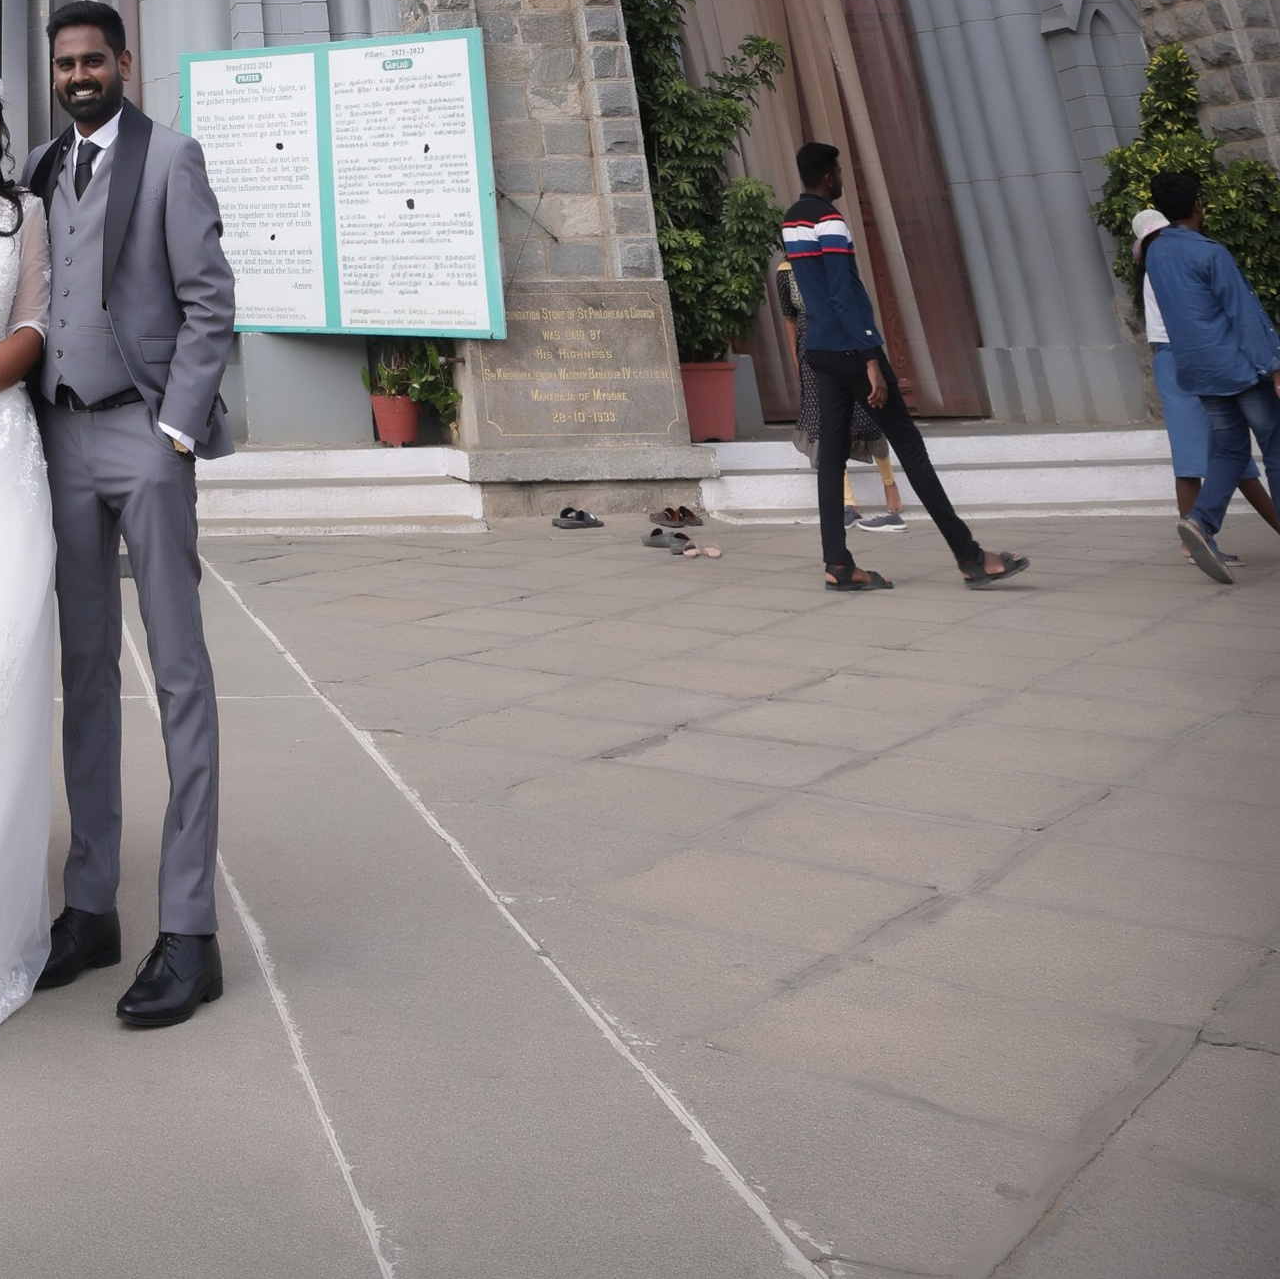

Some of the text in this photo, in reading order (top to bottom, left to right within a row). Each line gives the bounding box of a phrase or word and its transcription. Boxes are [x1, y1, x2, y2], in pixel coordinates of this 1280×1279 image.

[391, 48, 425, 56] 2021-2023
[243, 62, 272, 70] 2021-2023
[206, 98, 224, 107] gather
[226, 97, 250, 105] together
[506, 310, 540, 321] OUNDATION
[568, 310, 576, 320] OF
[542, 330, 601, 340] WAS LAID BY
[536, 348, 612, 359] HIS HIGHNESS
[579, 392, 589, 400] OF
